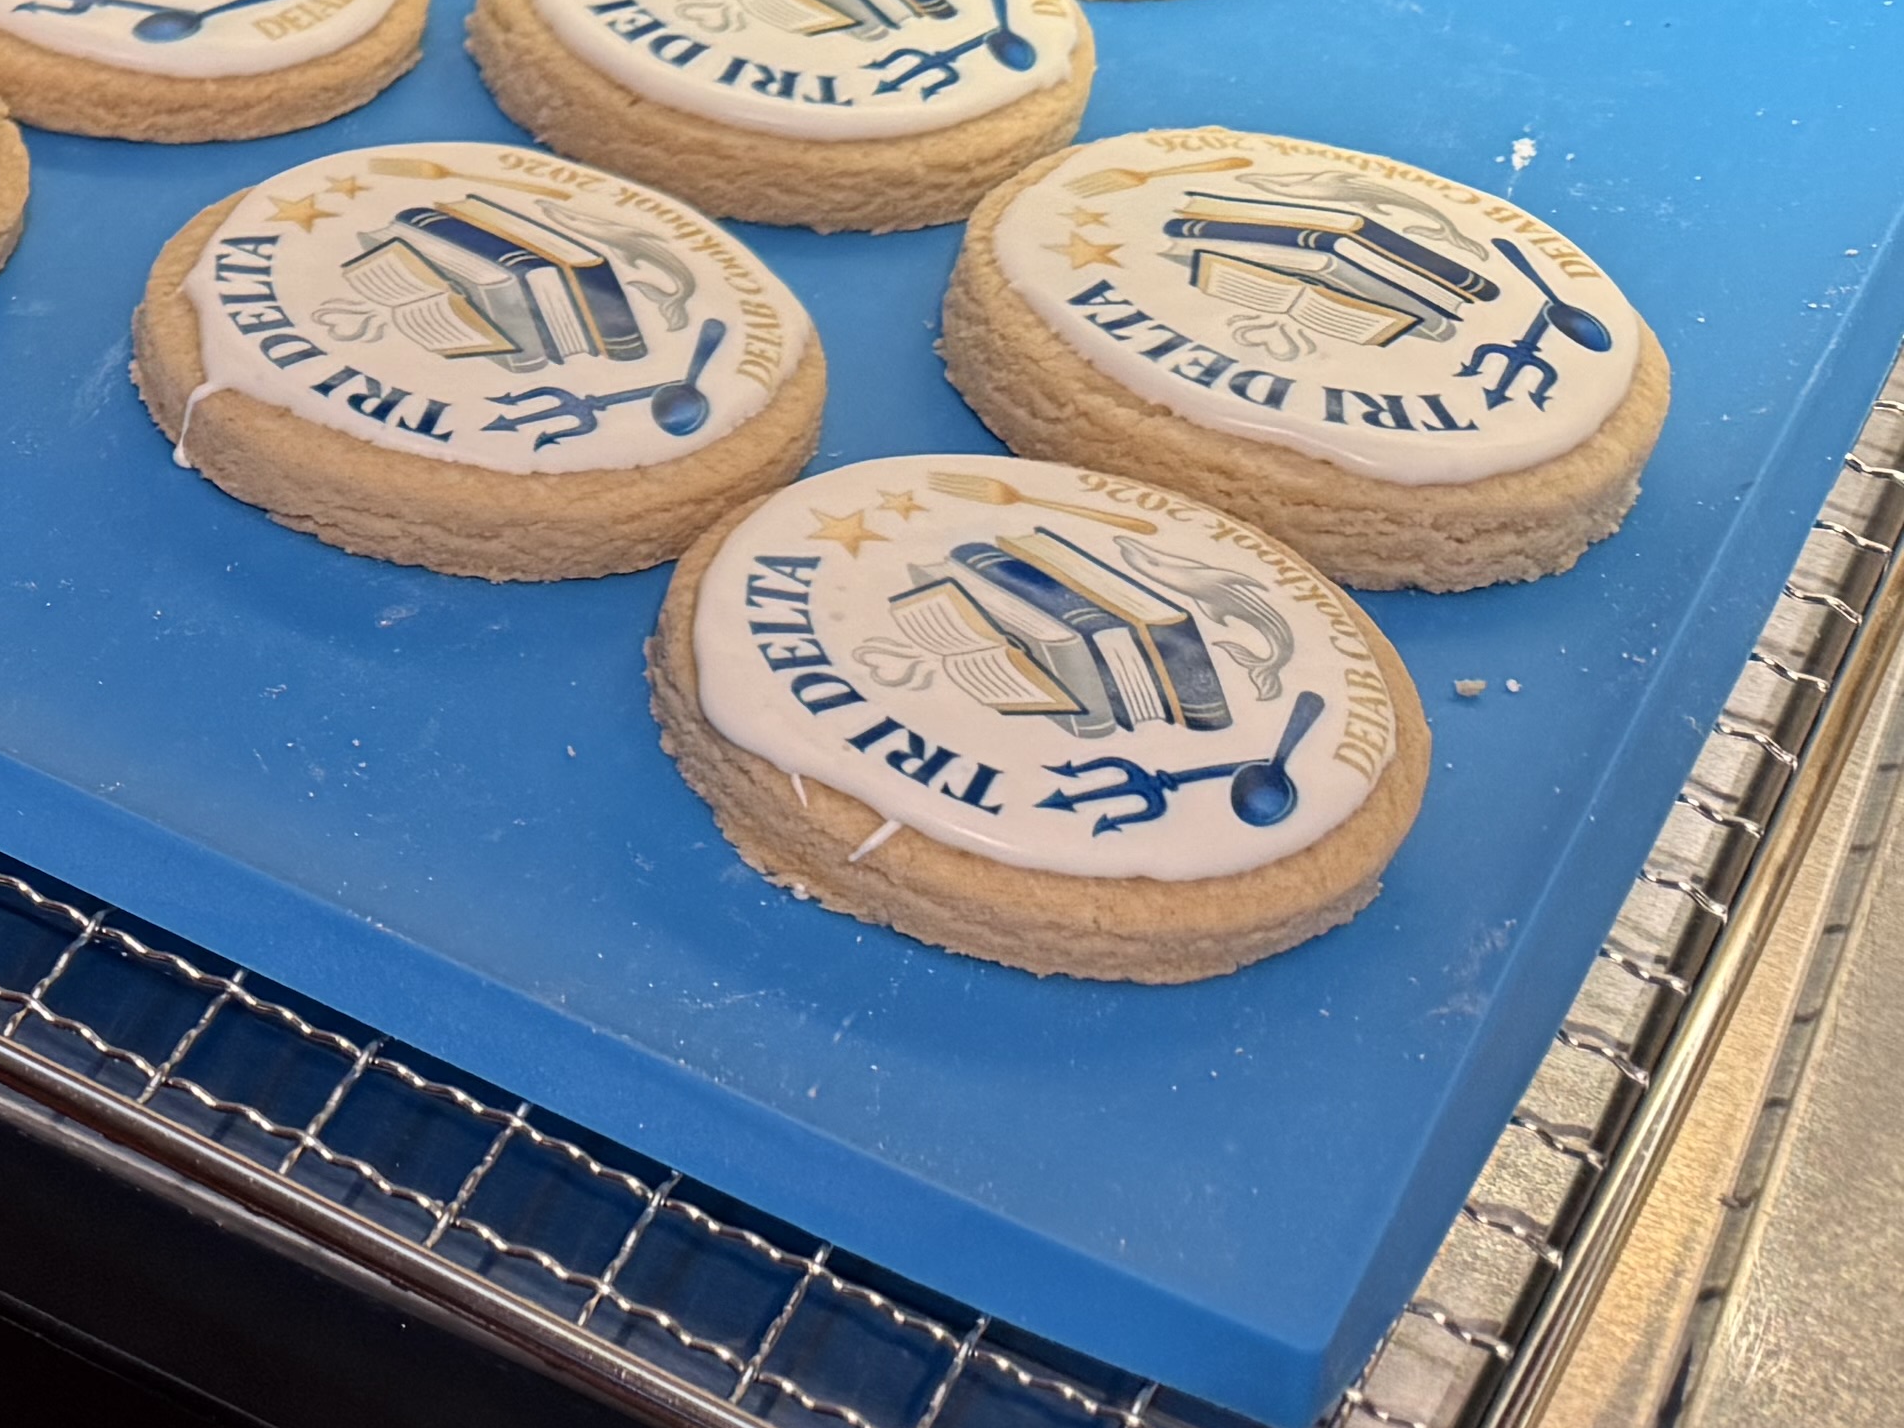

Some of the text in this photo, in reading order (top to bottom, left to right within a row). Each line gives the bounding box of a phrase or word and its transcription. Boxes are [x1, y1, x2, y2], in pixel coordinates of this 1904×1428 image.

[716, 55, 854, 107] TRI
[497, 152, 783, 392] DEIAB Cookbook 2026
[1145, 134, 1603, 281] DEIAB Cookbook 2026
[214, 233, 454, 444] TRI DELTA
[1066, 278, 1480, 433] TRI DELTA
[744, 553, 1006, 817] TRI DELTA
[1077, 472, 1390, 784] DEIAB Cookbook 2026
